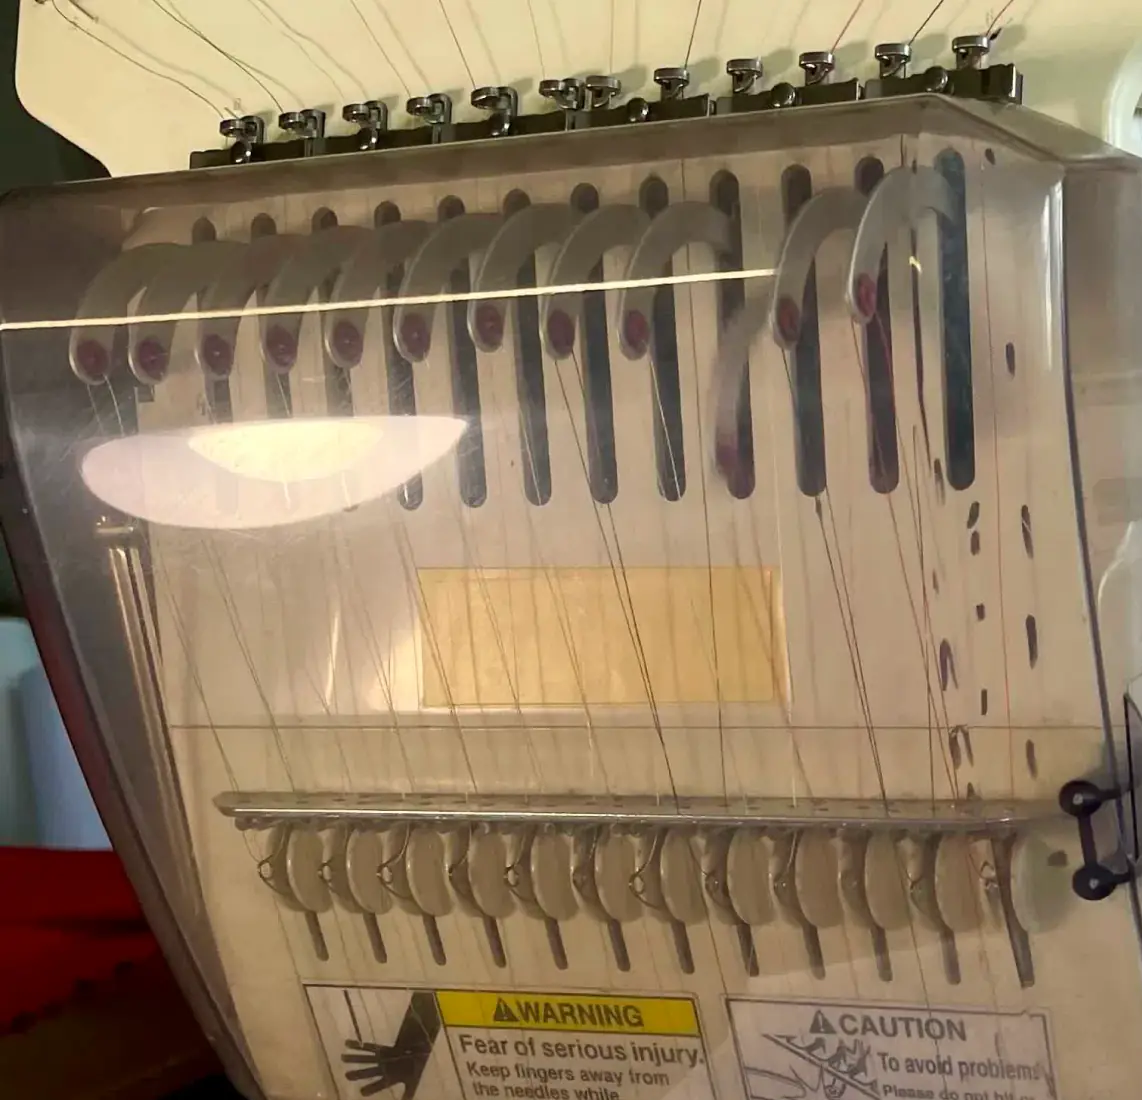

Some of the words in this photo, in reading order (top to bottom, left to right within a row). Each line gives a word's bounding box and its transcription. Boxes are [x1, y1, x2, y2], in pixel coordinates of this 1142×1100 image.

[515, 998, 645, 1028] WARNING
[838, 1013, 967, 1042] CAUTION
[459, 1033, 509, 1056] Fear
[514, 1036, 536, 1057] of
[542, 1039, 627, 1061] serious
[630, 1041, 705, 1069] injury.
[877, 1051, 901, 1074] To
[905, 1055, 953, 1076] avoid
[466, 1060, 511, 1081] Keep
[514, 1062, 576, 1084] fingers
[580, 1068, 623, 1088] away
[628, 1067, 670, 1087] from
[472, 1081, 500, 1098] the
[504, 1083, 571, 1100] needles
[882, 1083, 936, 1100] Please
